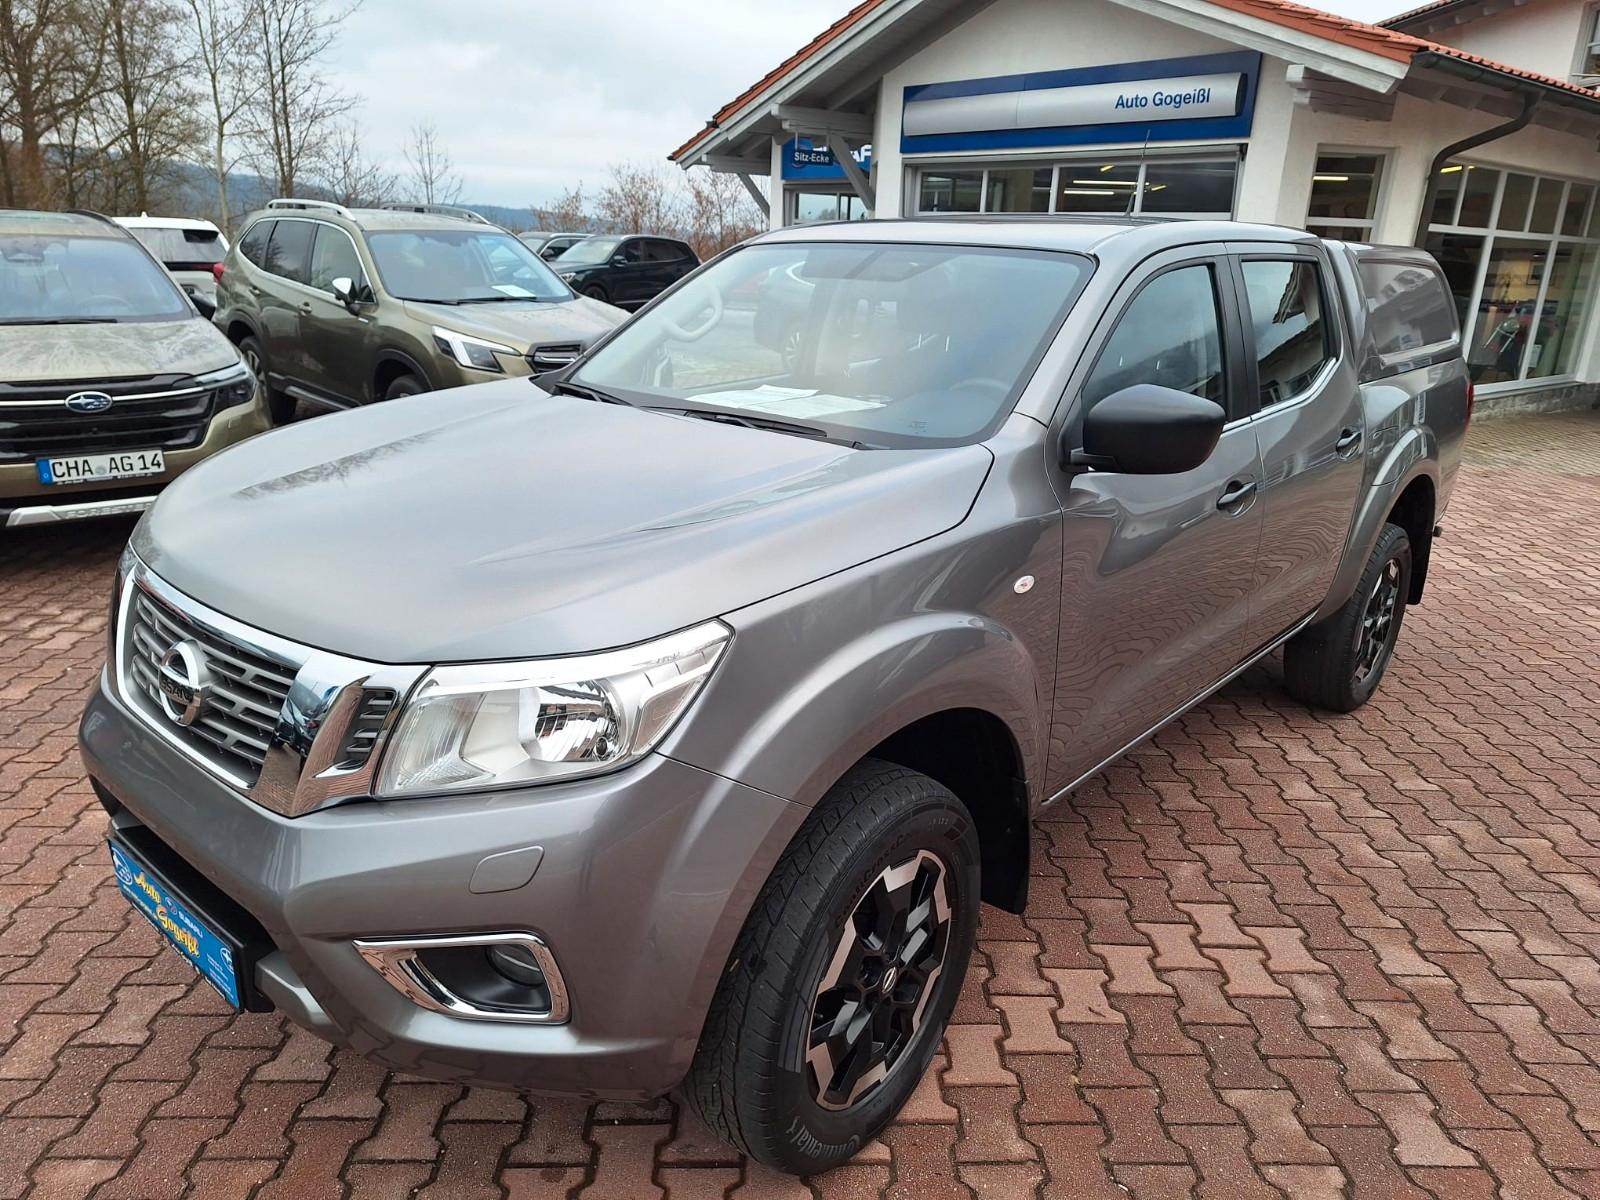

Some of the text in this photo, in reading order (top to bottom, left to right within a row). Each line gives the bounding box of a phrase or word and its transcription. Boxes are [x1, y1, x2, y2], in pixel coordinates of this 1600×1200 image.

[1115, 88, 1211, 109] Auto Gogeißl
[793, 151, 830, 163] Sitz-Ecke
[51, 453, 161, 478] CHA AG 14
